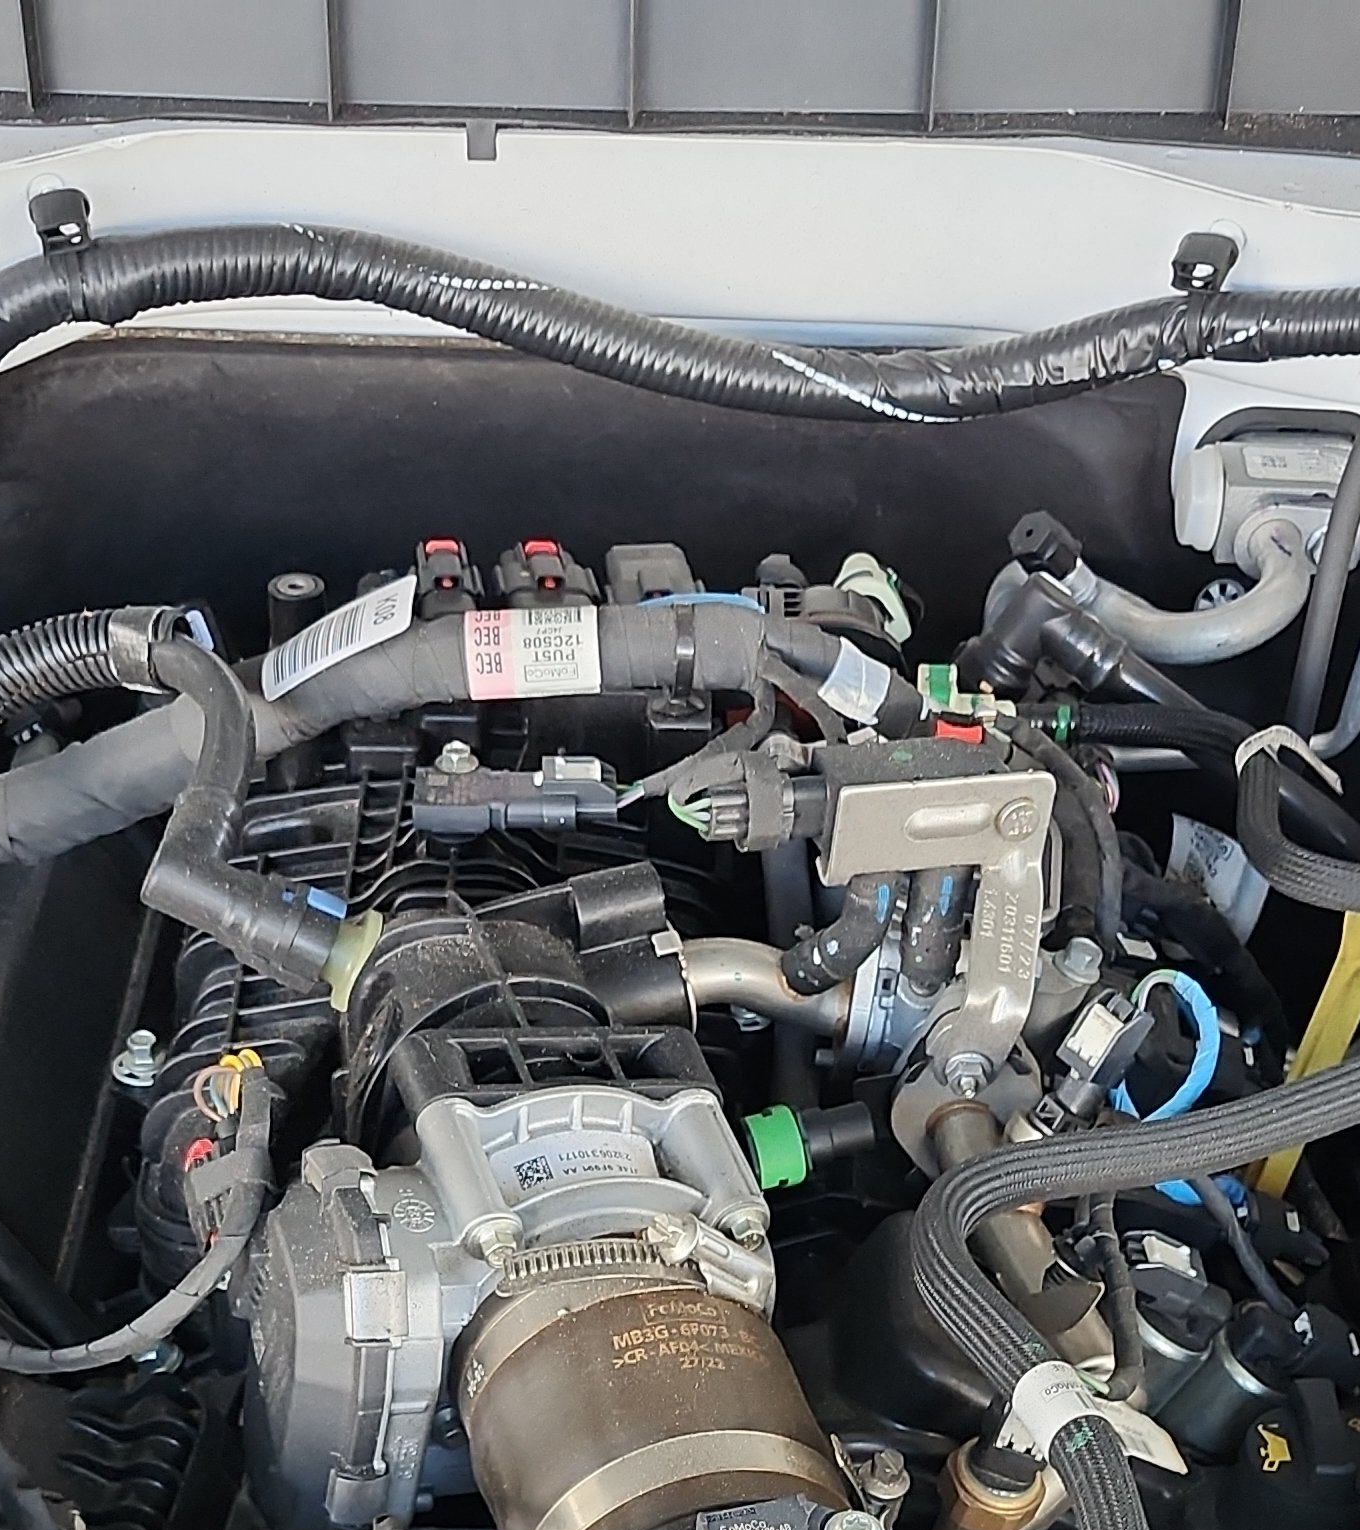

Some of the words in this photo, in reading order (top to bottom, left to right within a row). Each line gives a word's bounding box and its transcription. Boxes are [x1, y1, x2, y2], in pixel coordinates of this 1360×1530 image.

[373, 592, 398, 626] K08
[474, 626, 501, 646] BEC
[522, 635, 583, 649] 12C508
[476, 652, 503, 674] BEC
[532, 650, 576, 662] PU5T
